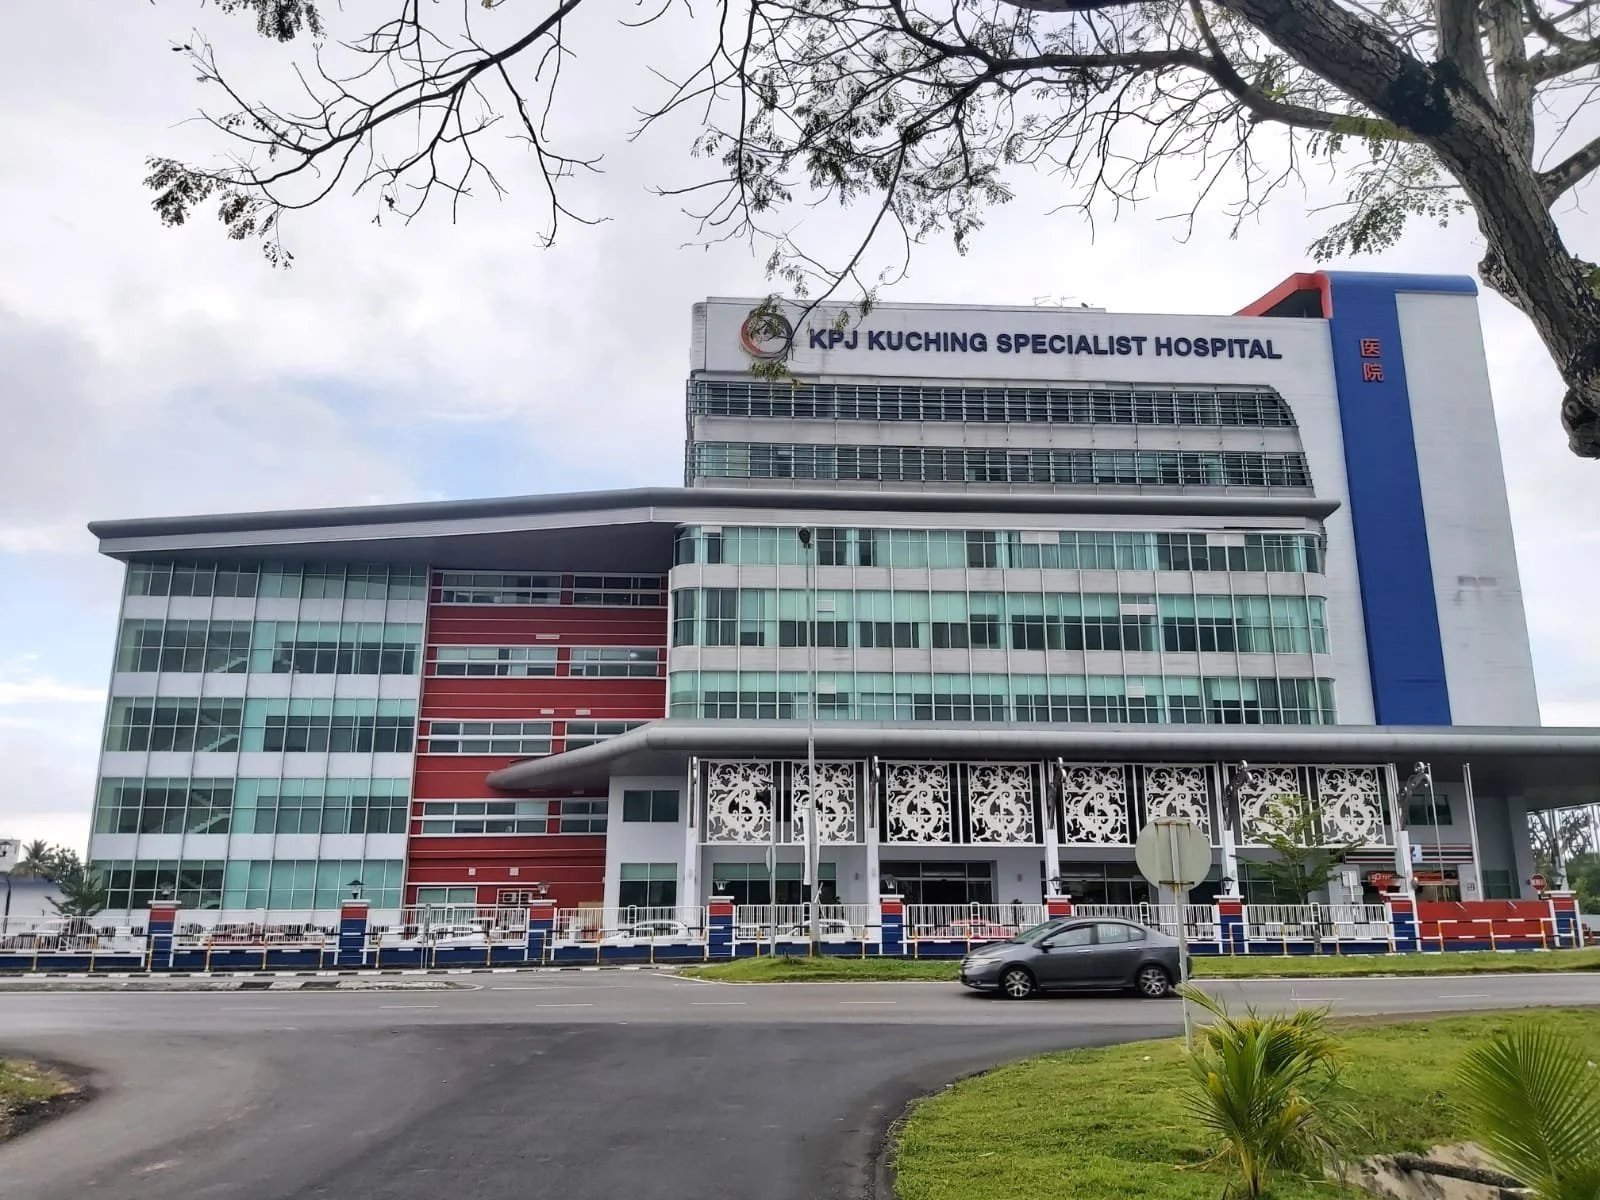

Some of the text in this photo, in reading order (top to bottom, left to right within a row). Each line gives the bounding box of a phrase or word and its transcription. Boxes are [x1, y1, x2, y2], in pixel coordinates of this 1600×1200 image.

[809, 328, 1283, 360] KPJ KUCHING SPECIALIST HOSPITAL
[1360, 337, 1385, 383] 医院
